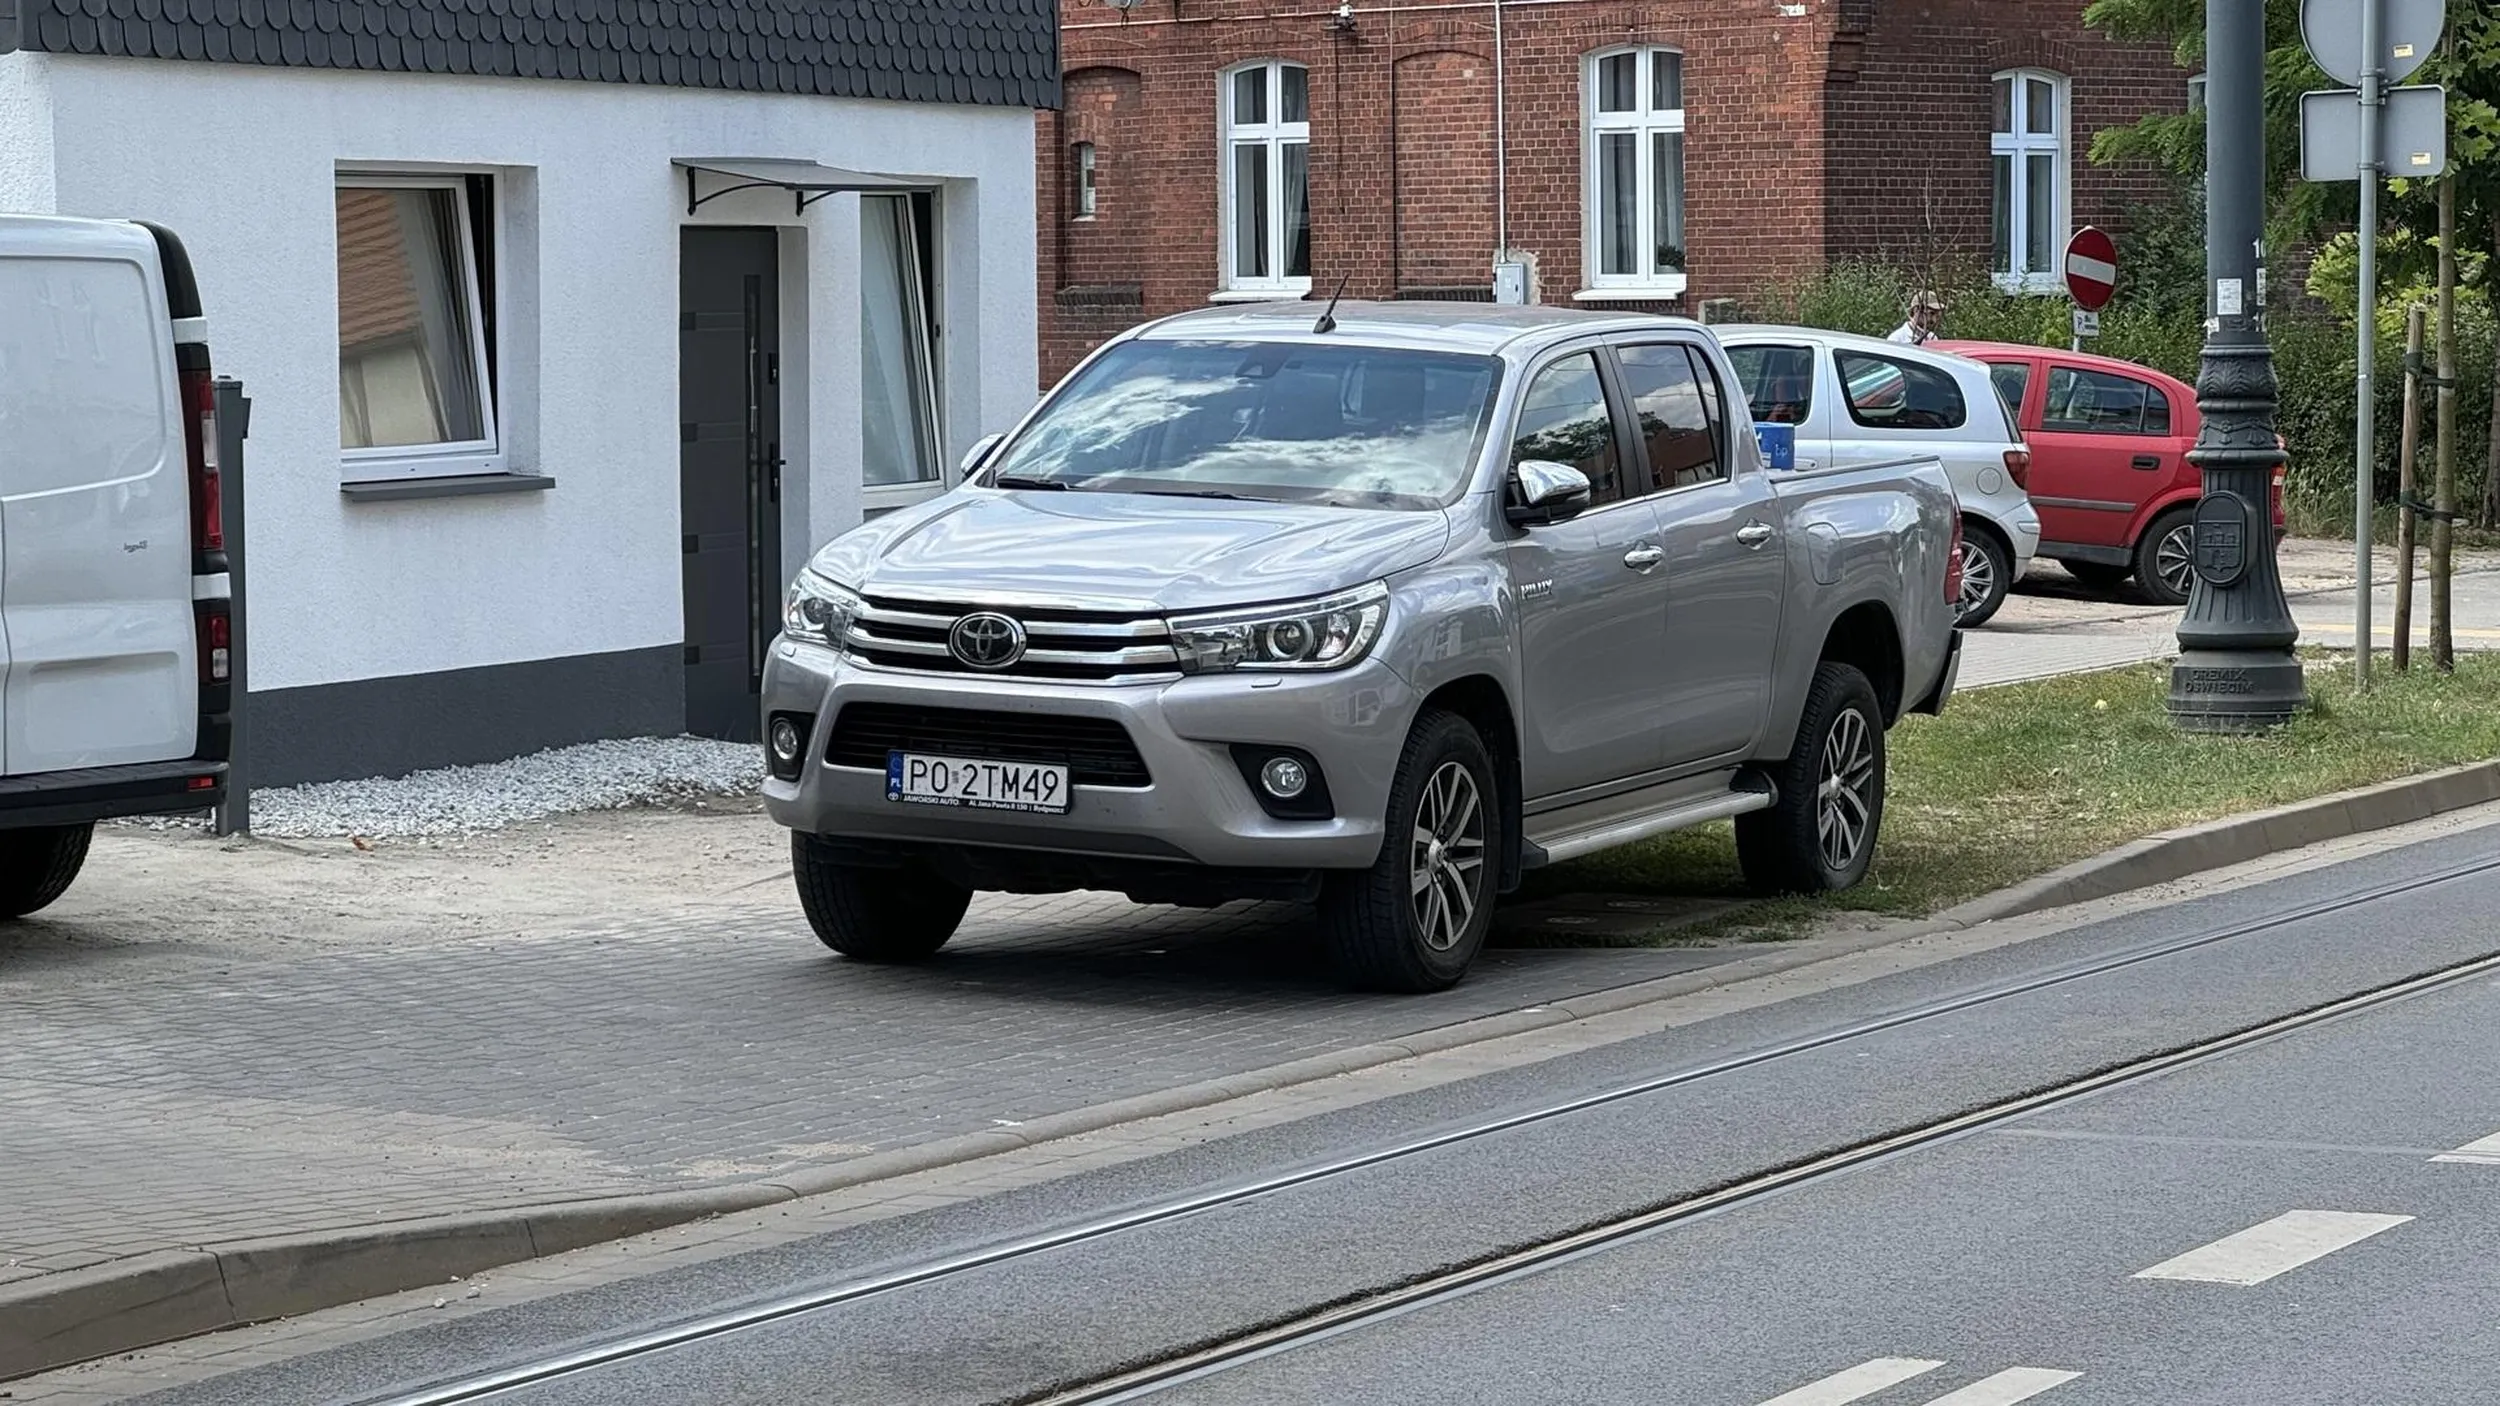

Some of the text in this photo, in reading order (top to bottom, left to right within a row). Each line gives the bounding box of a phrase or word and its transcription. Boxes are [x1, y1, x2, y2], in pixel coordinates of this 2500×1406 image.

[890, 777, 901, 788] PL
[910, 759, 1059, 801] PO 2TM49
[939, 798, 960, 806] AUTO
